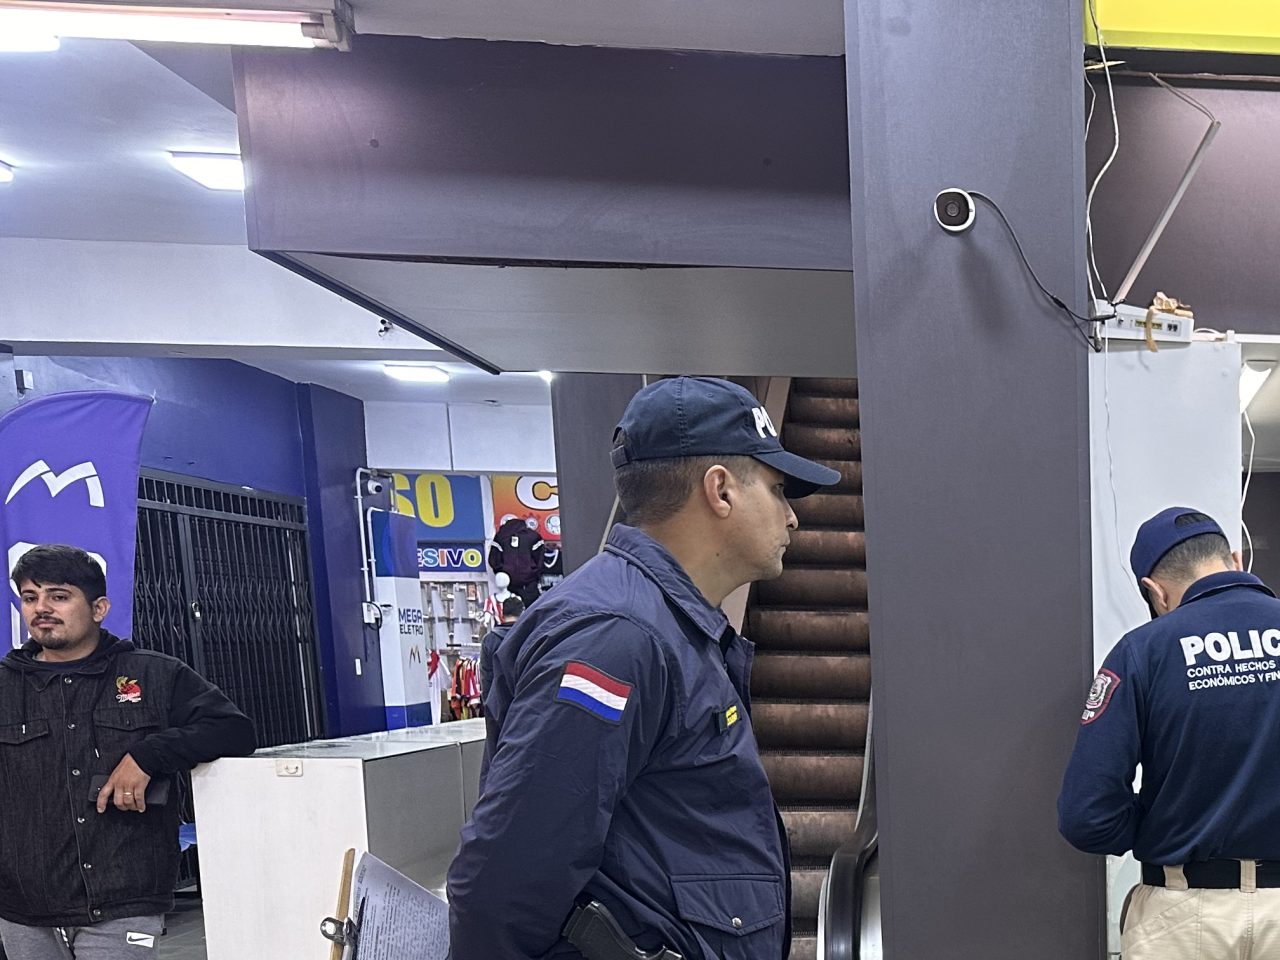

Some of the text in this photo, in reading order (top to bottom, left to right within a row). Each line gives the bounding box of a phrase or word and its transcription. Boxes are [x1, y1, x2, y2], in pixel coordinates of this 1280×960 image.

[398, 608, 423, 624] MEGA
[399, 624, 424, 636] ELETRO
[1186, 664, 1233, 678] CONTRA
[1234, 660, 1277, 674] HECHOS
[1188, 672, 1256, 691] ECONÓMICOS
[1257, 672, 1265, 683] Y
